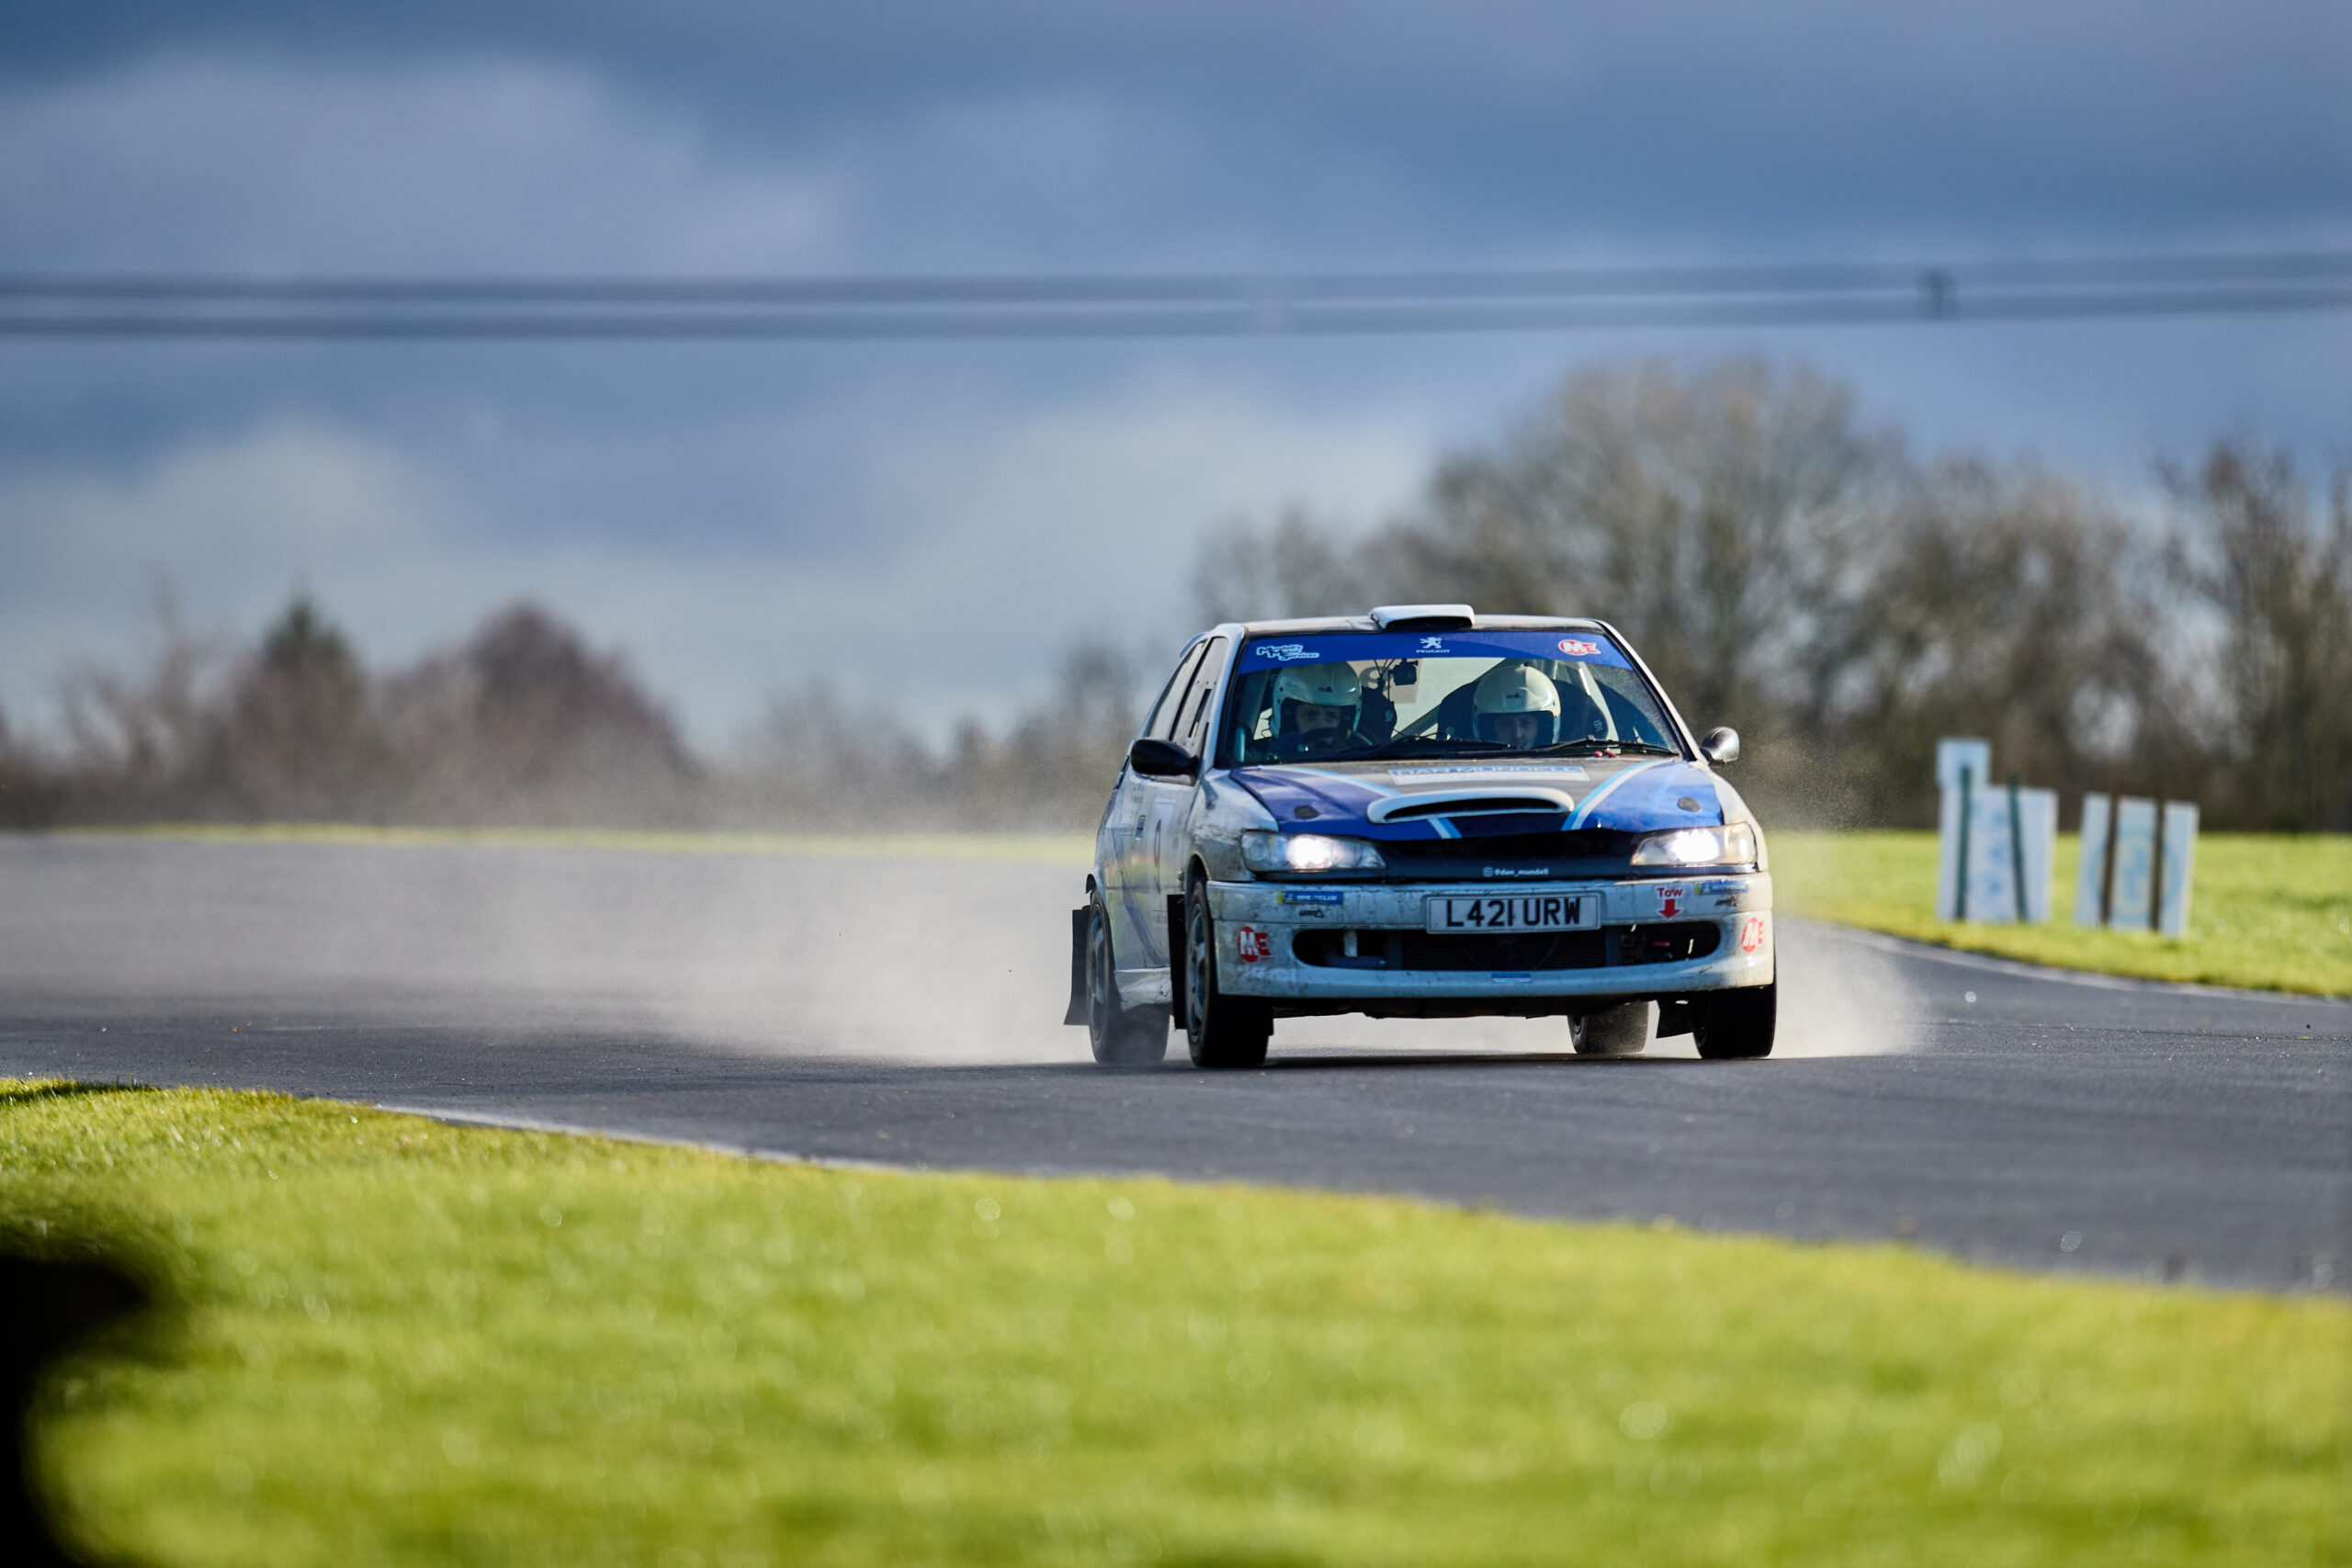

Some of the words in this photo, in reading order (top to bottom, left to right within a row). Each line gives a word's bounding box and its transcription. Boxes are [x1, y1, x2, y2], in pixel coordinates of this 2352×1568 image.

[1494, 868, 1549, 876] @dan_mundell
[1447, 899, 1514, 927] L421
[1523, 897, 1581, 926] URW
